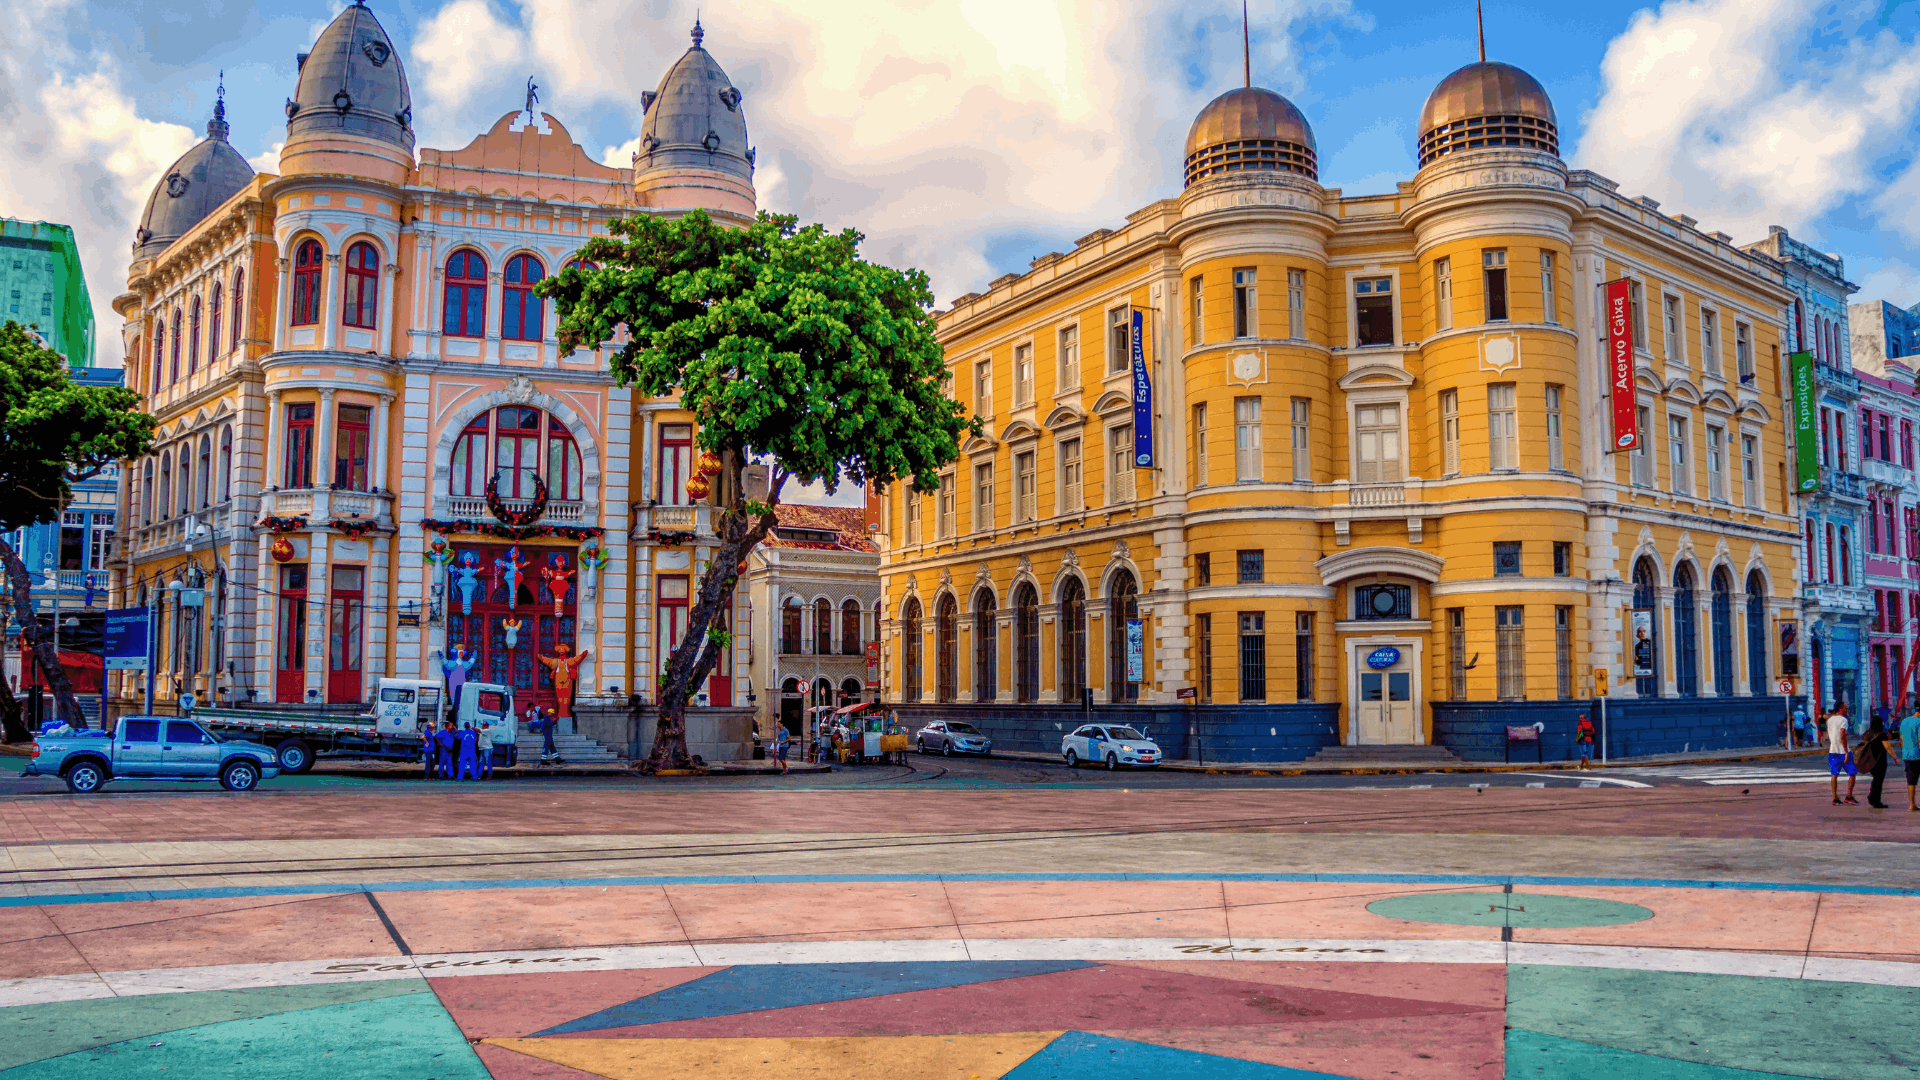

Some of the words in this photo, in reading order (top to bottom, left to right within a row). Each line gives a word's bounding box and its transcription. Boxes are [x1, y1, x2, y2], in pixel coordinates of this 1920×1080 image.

[1613, 296, 1625, 336] Caixa
[1133, 326, 1149, 403] Espetáculos
[1616, 340, 1628, 389] Acervo
[1797, 365, 1811, 430] Exposições
[311, 956, 604, 975] Saturno
[1173, 944, 1387, 954] Urano
